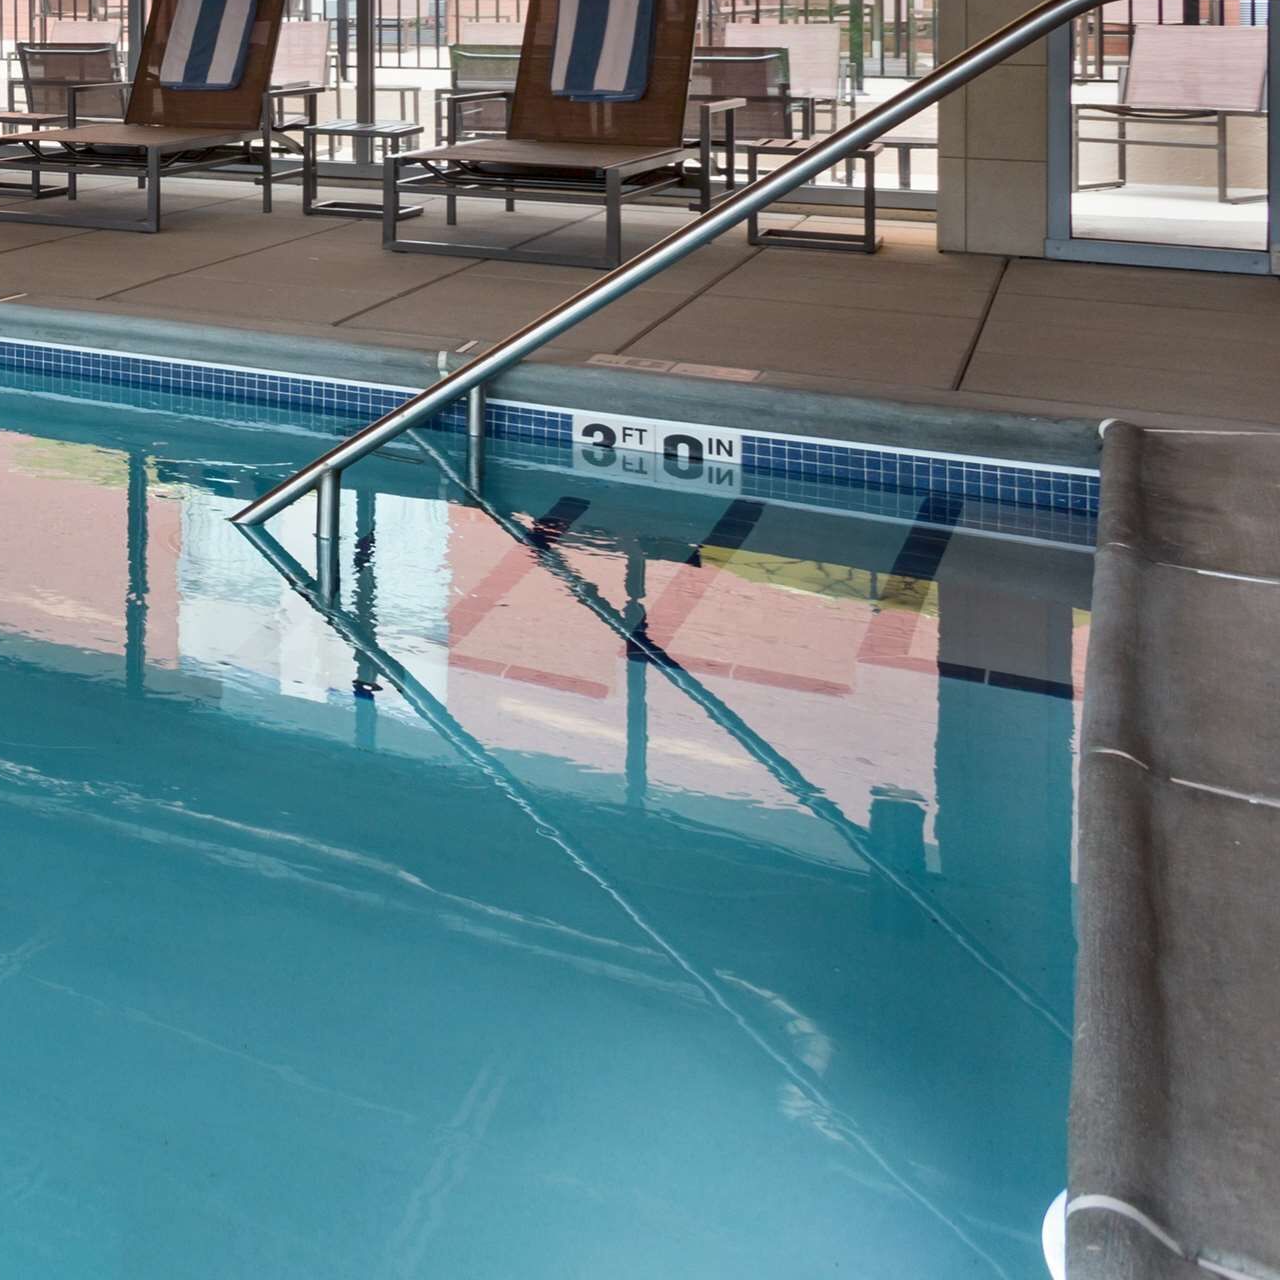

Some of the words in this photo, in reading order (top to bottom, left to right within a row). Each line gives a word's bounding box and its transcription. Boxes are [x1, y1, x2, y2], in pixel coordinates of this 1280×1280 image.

[581, 423, 617, 462] 3
[622, 426, 647, 446] FT
[663, 434, 704, 477] 0
[707, 437, 734, 458] IN
